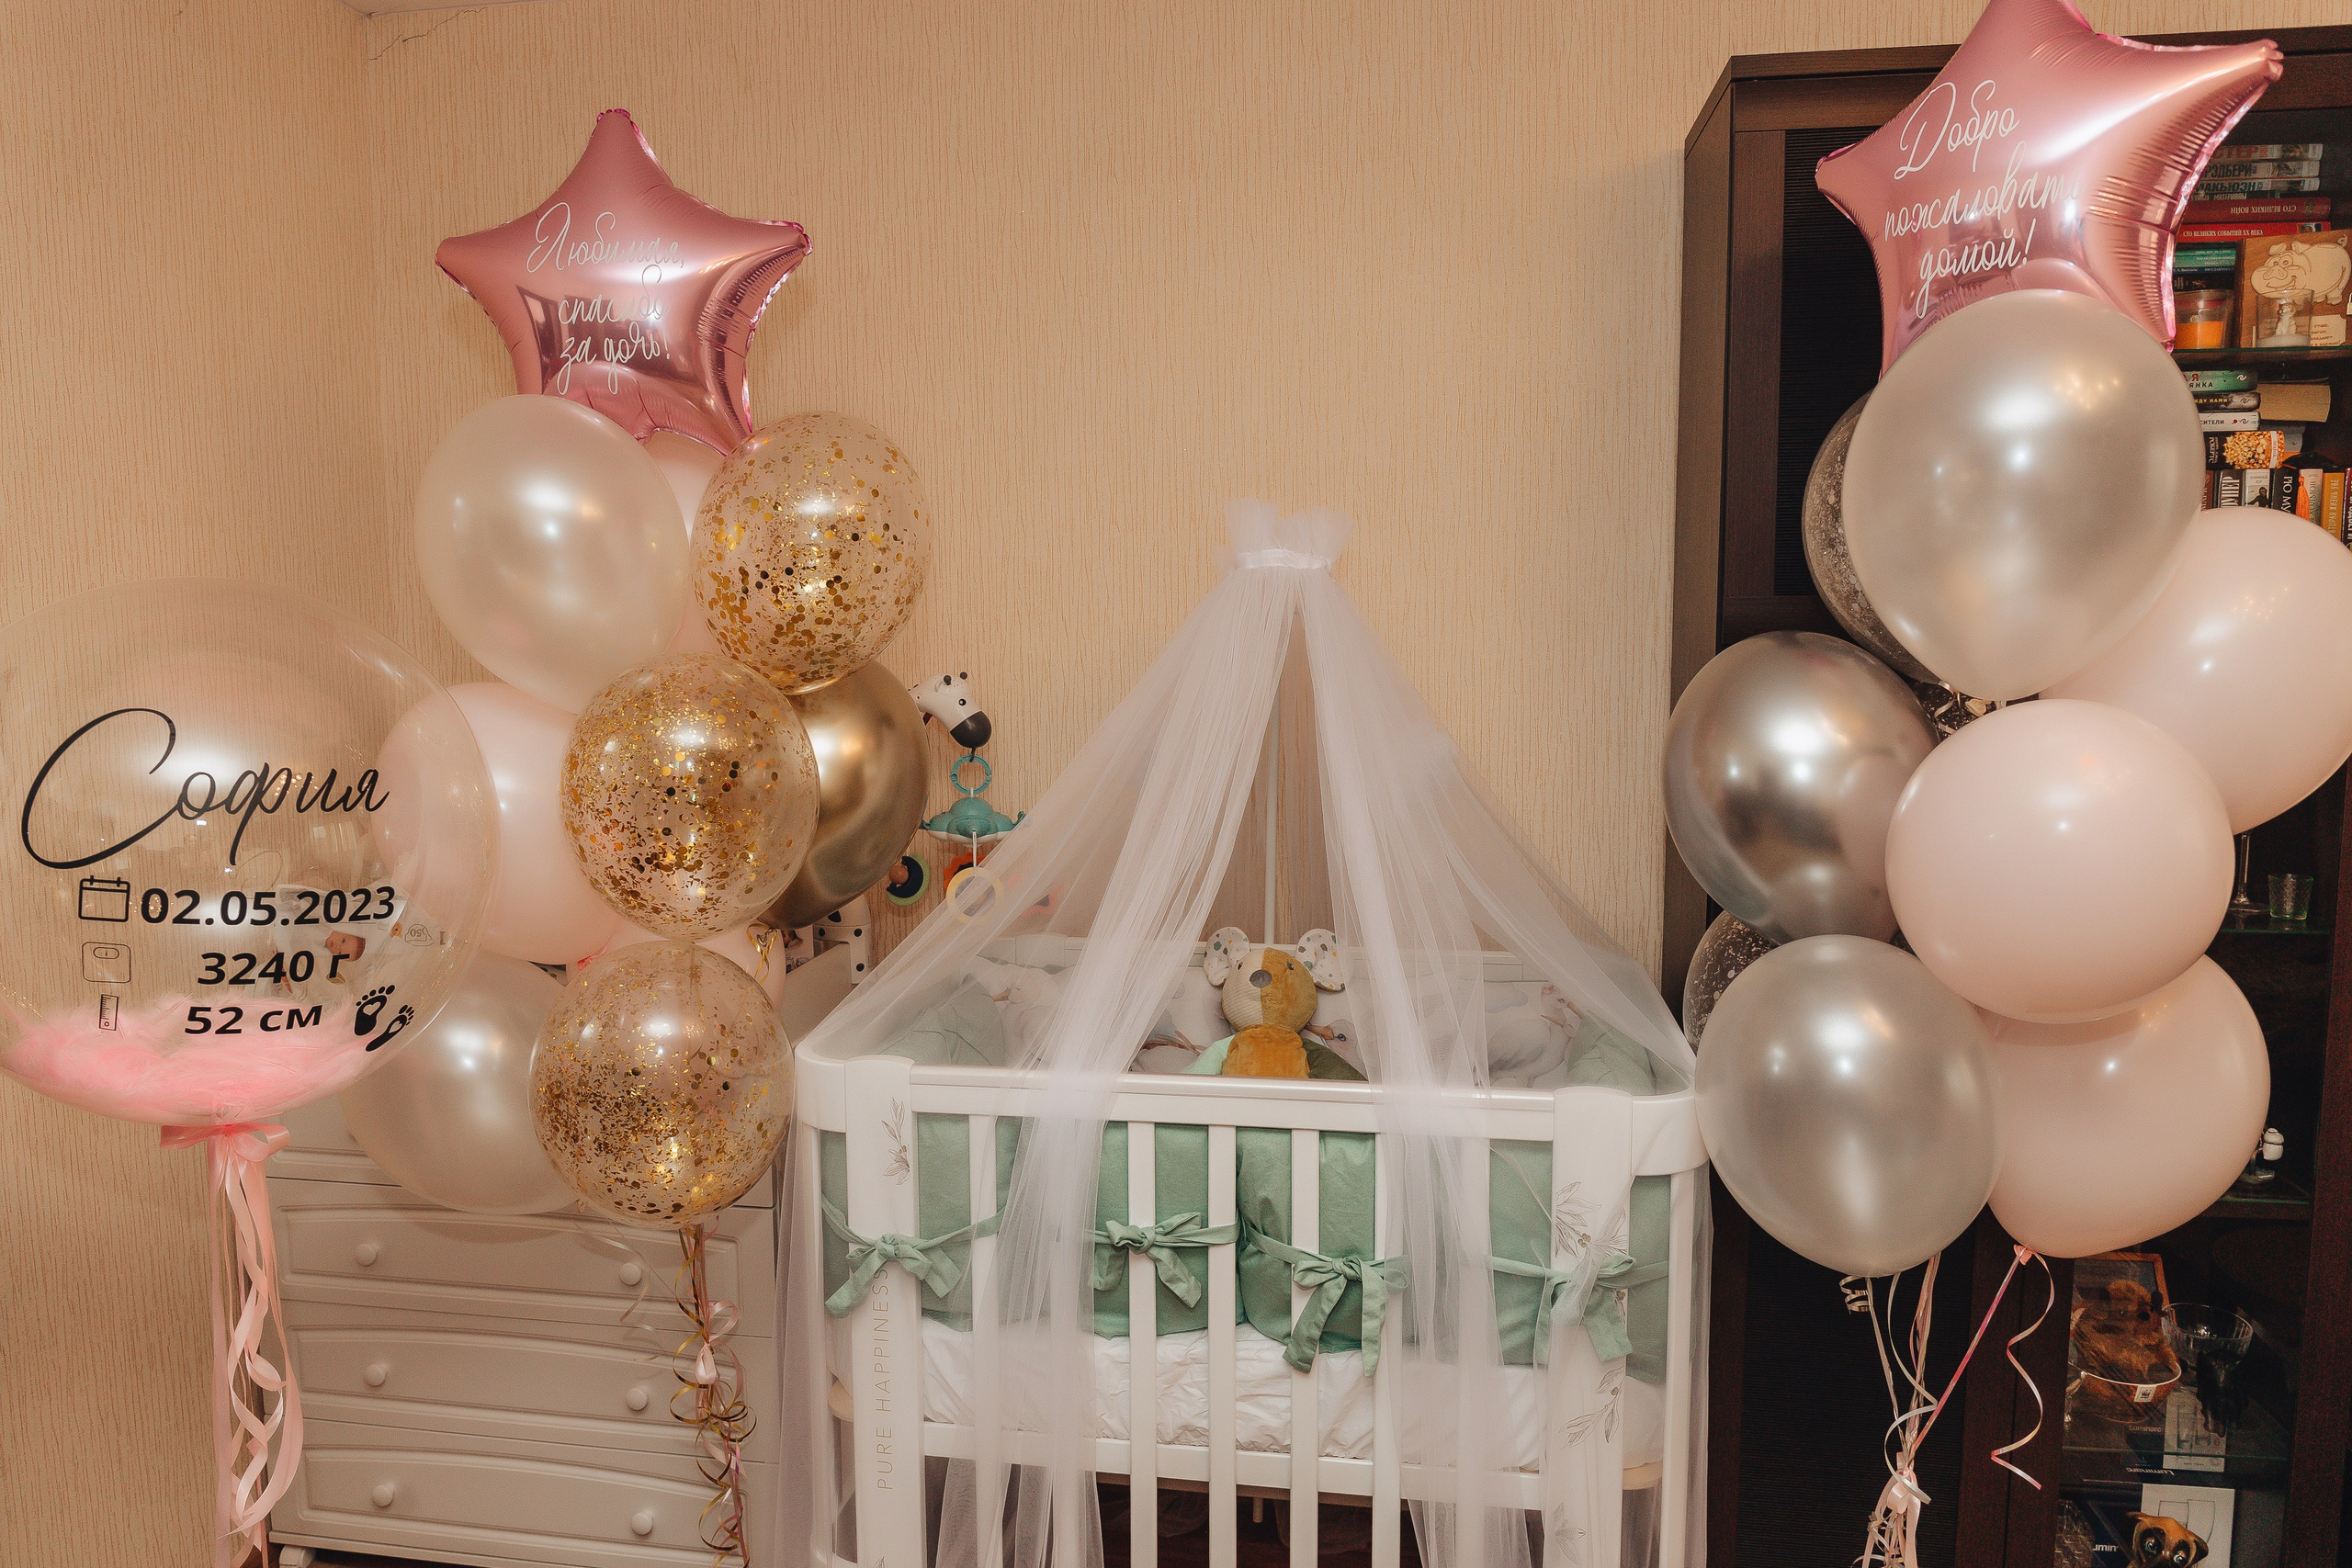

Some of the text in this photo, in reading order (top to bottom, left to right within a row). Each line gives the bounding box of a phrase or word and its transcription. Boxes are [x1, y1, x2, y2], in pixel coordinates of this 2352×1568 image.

[1894, 80, 2020, 180] Добро
[2212, 145, 2259, 159] СТЕР
[1883, 141, 2086, 241] пожаловать
[2205, 163, 2252, 178] РЭДБЕРИ
[2250, 205, 2281, 213] ВЕЛИКИХ
[1917, 218, 2038, 319] домой!
[558, 265, 670, 325] спасибо
[555, 321, 671, 395] за дочь!
[2280, 476, 2293, 513] РЮ МУ
[21, 707, 390, 869] София
[140, 886, 396, 926] 02.05.2023
[197, 950, 315, 986] 3240
[184, 1006, 245, 1035] 52
[871, 1268, 894, 1491] PURE HAPPINESS
